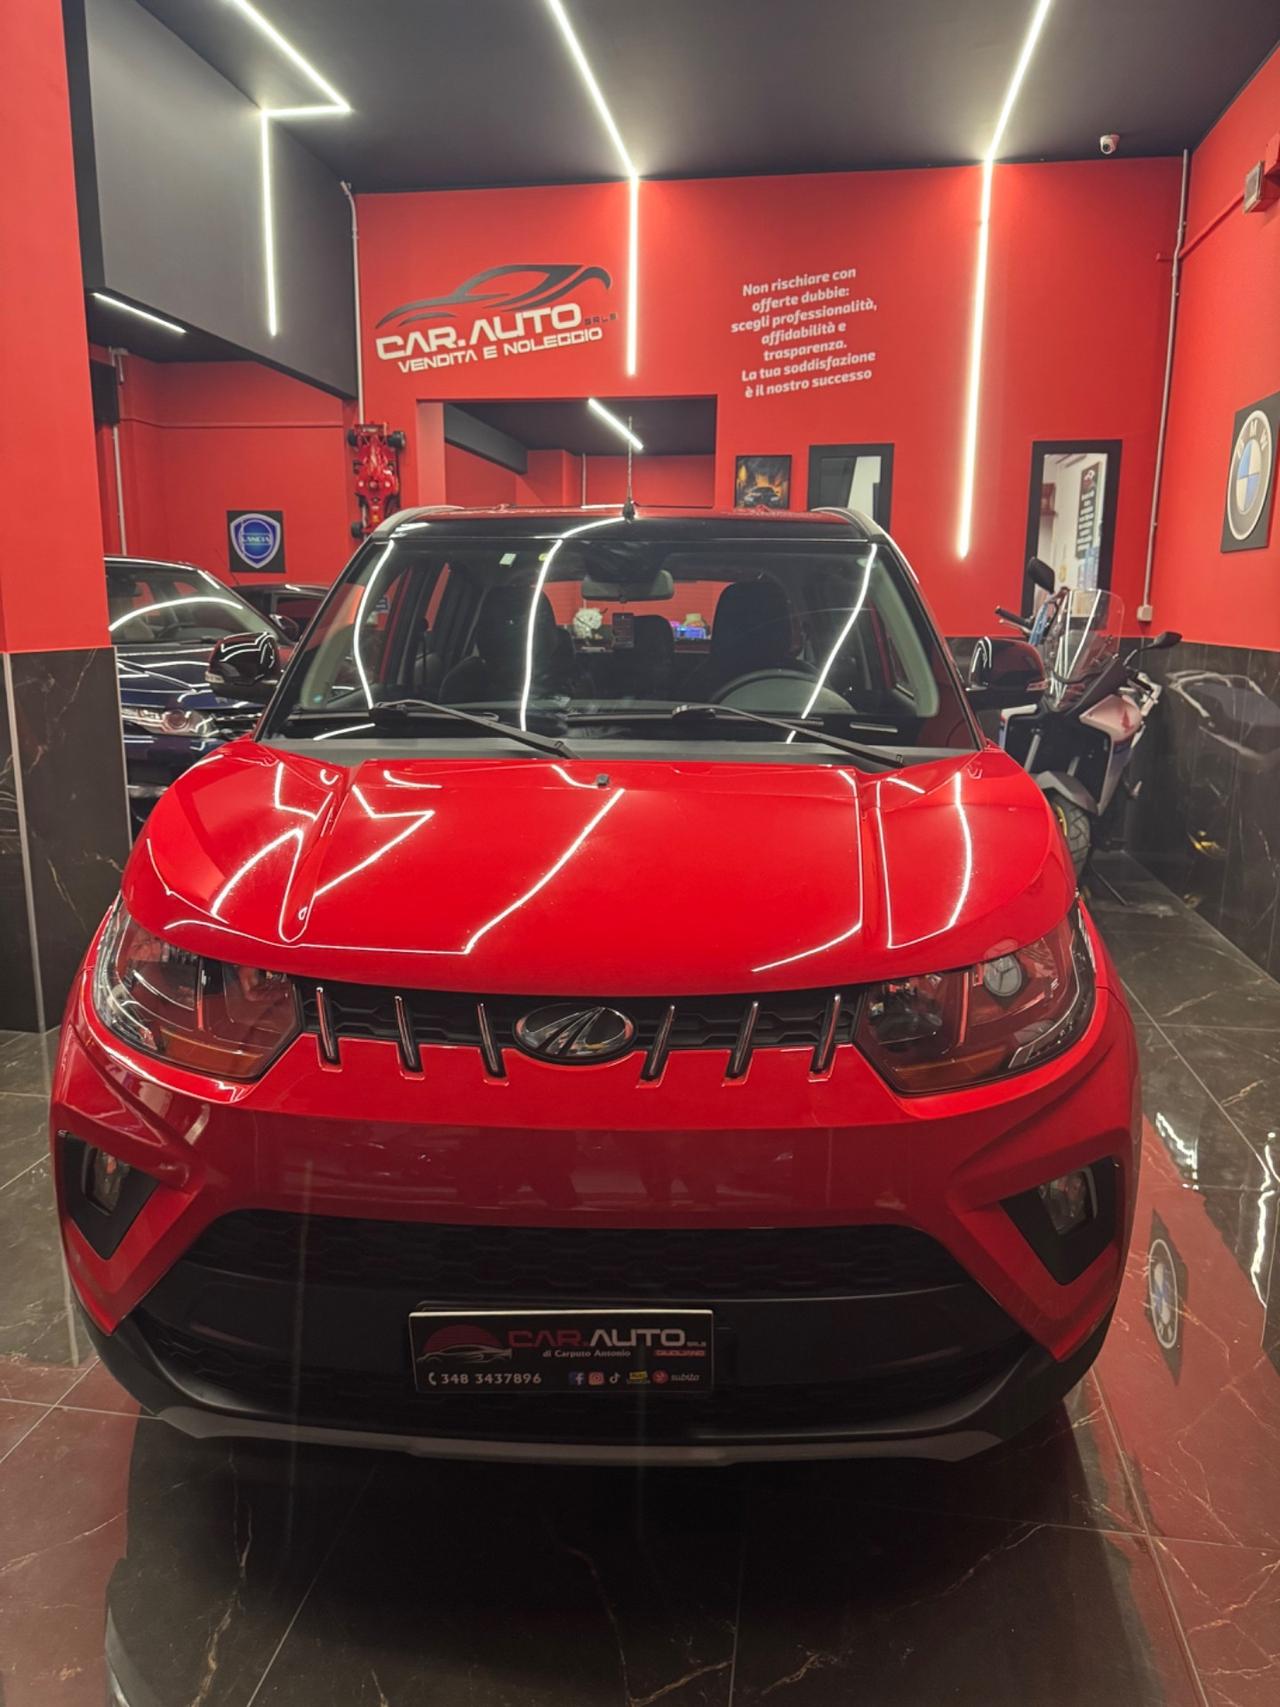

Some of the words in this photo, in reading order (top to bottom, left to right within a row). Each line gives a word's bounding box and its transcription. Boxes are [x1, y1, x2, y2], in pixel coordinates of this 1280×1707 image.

[743, 283, 768, 296] Non
[771, 272, 830, 291] rischiare
[832, 268, 856, 281] con
[752, 296, 799, 313] offerte
[801, 286, 849, 303] dubbie:
[731, 316, 770, 333] scegli
[772, 298, 877, 328] professionalità,
[375, 302, 582, 360] CAR.AUTO
[761, 321, 836, 346] affidabilità
[838, 322, 847, 332] e
[398, 350, 478, 373] VENDITA
[483, 345, 498, 359] E
[503, 327, 603, 356] NOLEGGIO
[763, 339, 847, 361] trasparenza.
[741, 370, 757, 382] La
[759, 366, 781, 378] tua
[783, 351, 876, 375] soddisfazione
[744, 386, 753, 398] è
[755, 384, 764, 397] il
[766, 379, 810, 395] nostro
[812, 369, 872, 388] successo
[594, 1349, 631, 1358] Antonio
[441, 1373, 469, 1384] 348
[475, 1372, 542, 1385] 3437896
